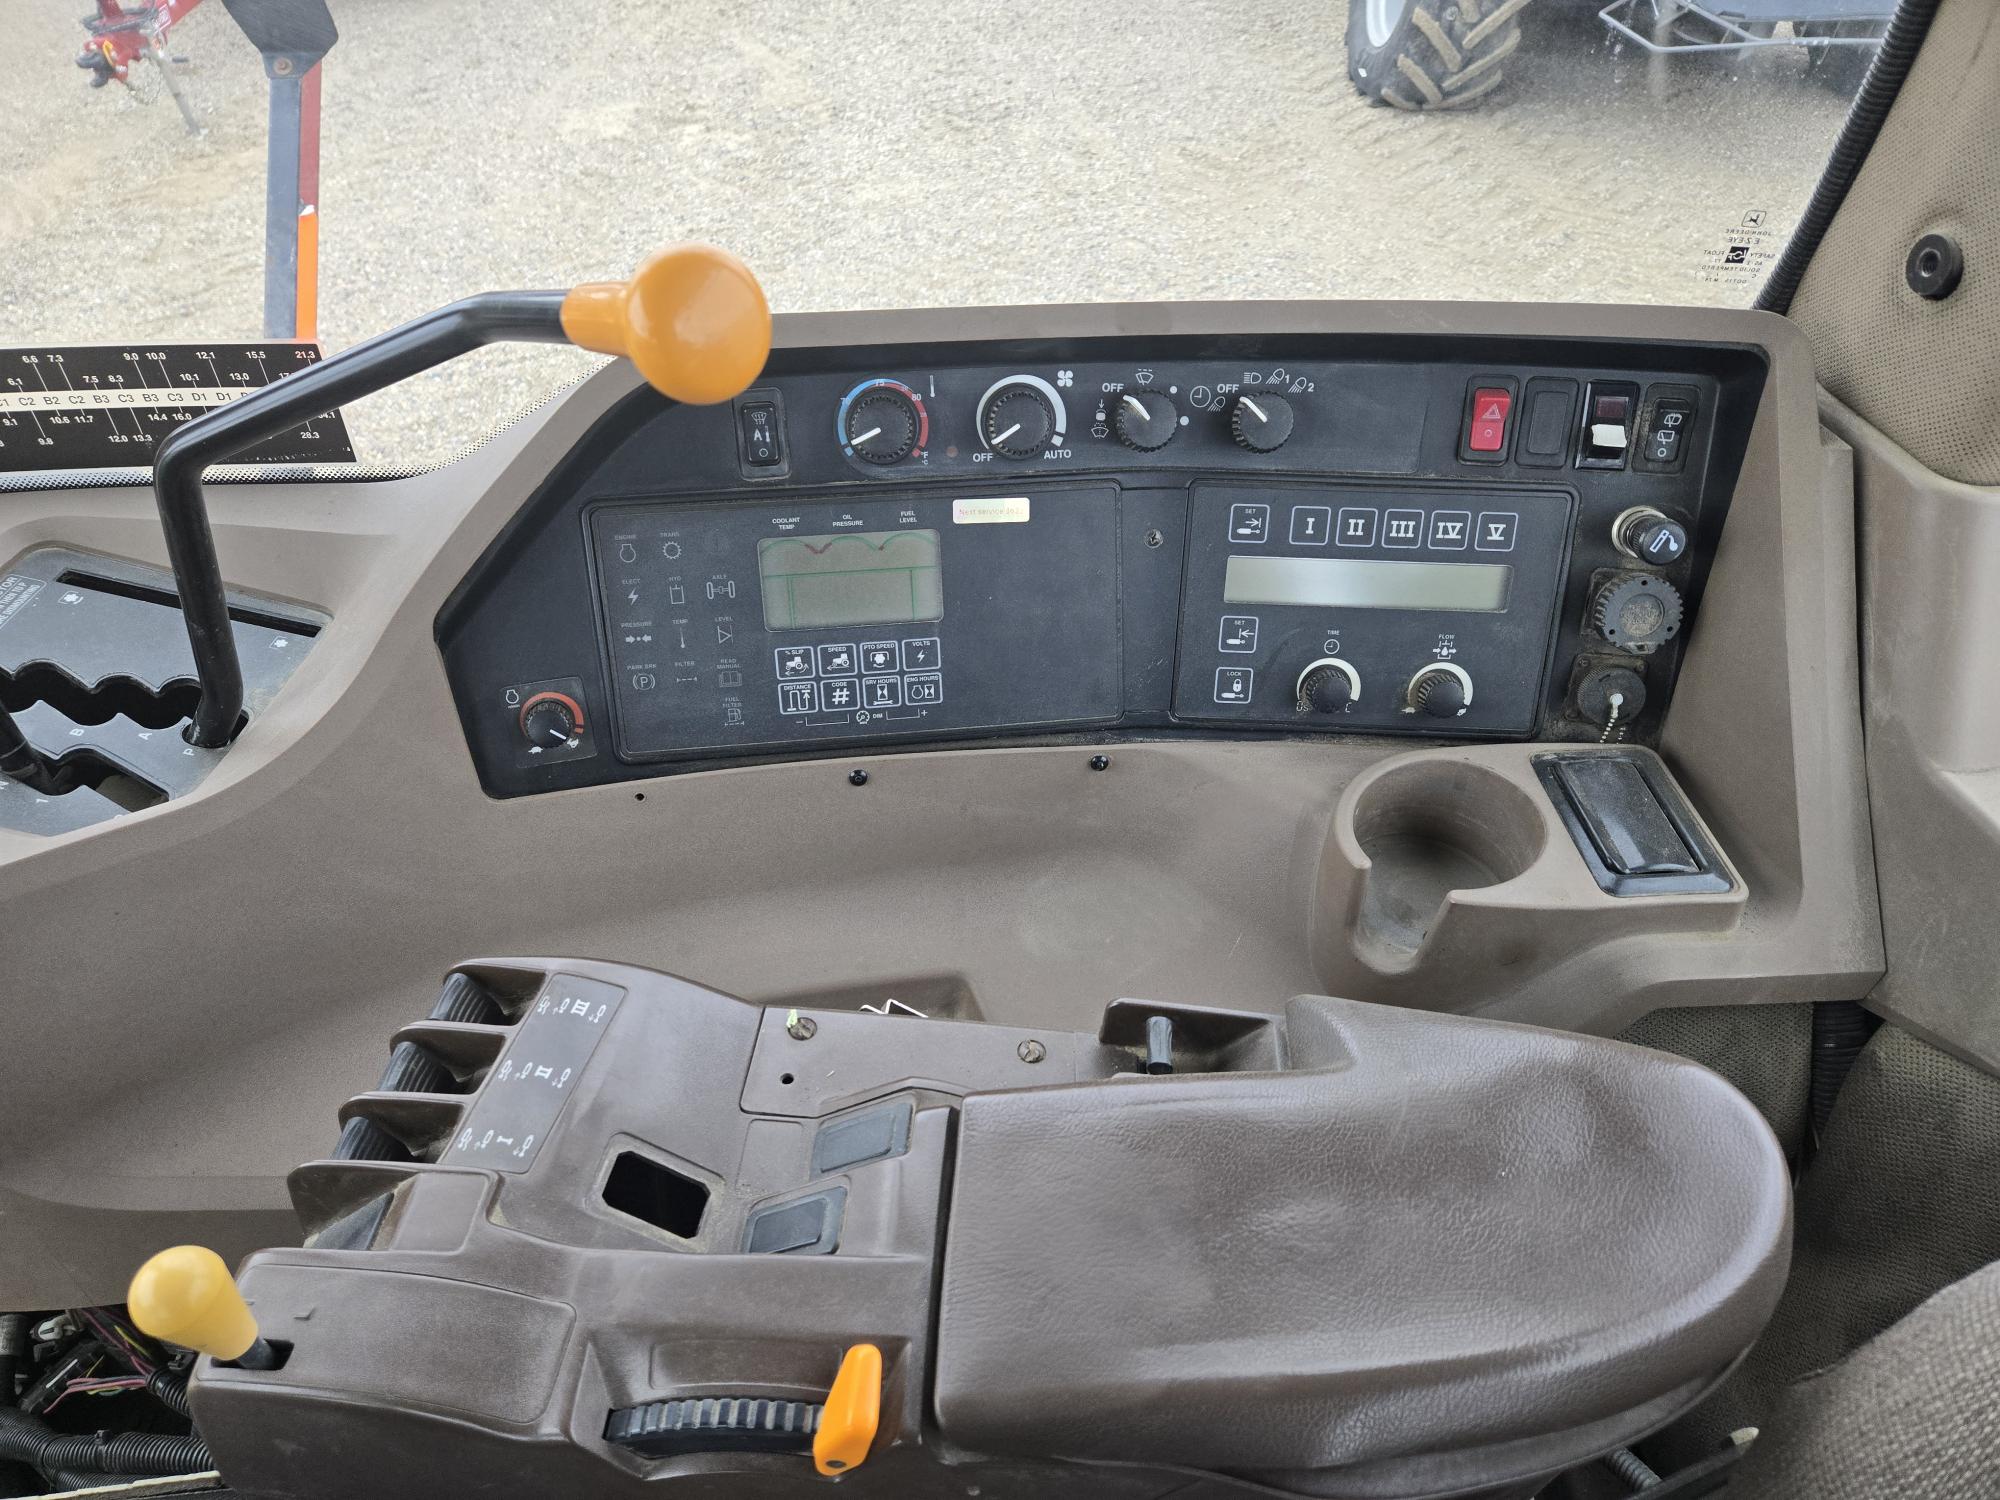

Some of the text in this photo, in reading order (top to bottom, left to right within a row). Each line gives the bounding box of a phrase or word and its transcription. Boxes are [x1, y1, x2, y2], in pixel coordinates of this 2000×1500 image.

[22, 355, 38, 363] 6.6
[47, 355, 64, 363] 7.3
[123, 352, 139, 361] 9.0
[146, 352, 166, 360] 10.0
[246, 351, 266, 359] 15.5
[295, 351, 316, 359] 21.3
[7, 378, 23, 386] 6.1
[83, 375, 99, 383] 7.5
[108, 375, 124, 383] 8.3
[180, 373, 200, 381] 10.1
[230, 373, 250, 381] 13.0
[1102, 383, 1125, 393] OFF
[1217, 384, 1240, 394] OFF
[1308, 383, 1315, 393] 2
[19, 397, 36, 406] C2
[43, 396, 60, 405] B2
[69, 395, 86, 404] C2
[93, 395, 110, 404] B3
[118, 394, 135, 403] C3
[143, 394, 159, 402] B3
[168, 393, 184, 402] C3
[192, 392, 208, 401] D1
[216, 392, 232, 401] D1
[3, 418, 18, 426] 9.1
[50, 416, 70, 424] 10.6
[172, 413, 192, 421] 16.0
[38, 434, 153, 446] 9.8 12.0 13.3
[973, 453, 994, 462] OFF
[1044, 450, 1072, 460] AUTO
[1347, 519, 1365, 536] II
[1390, 520, 1416, 538] III
[1436, 522, 1464, 539] IV
[1487, 523, 1506, 541] V
[69, 729, 85, 737] B
[138, 733, 153, 741] A
[184, 749, 197, 757] P
